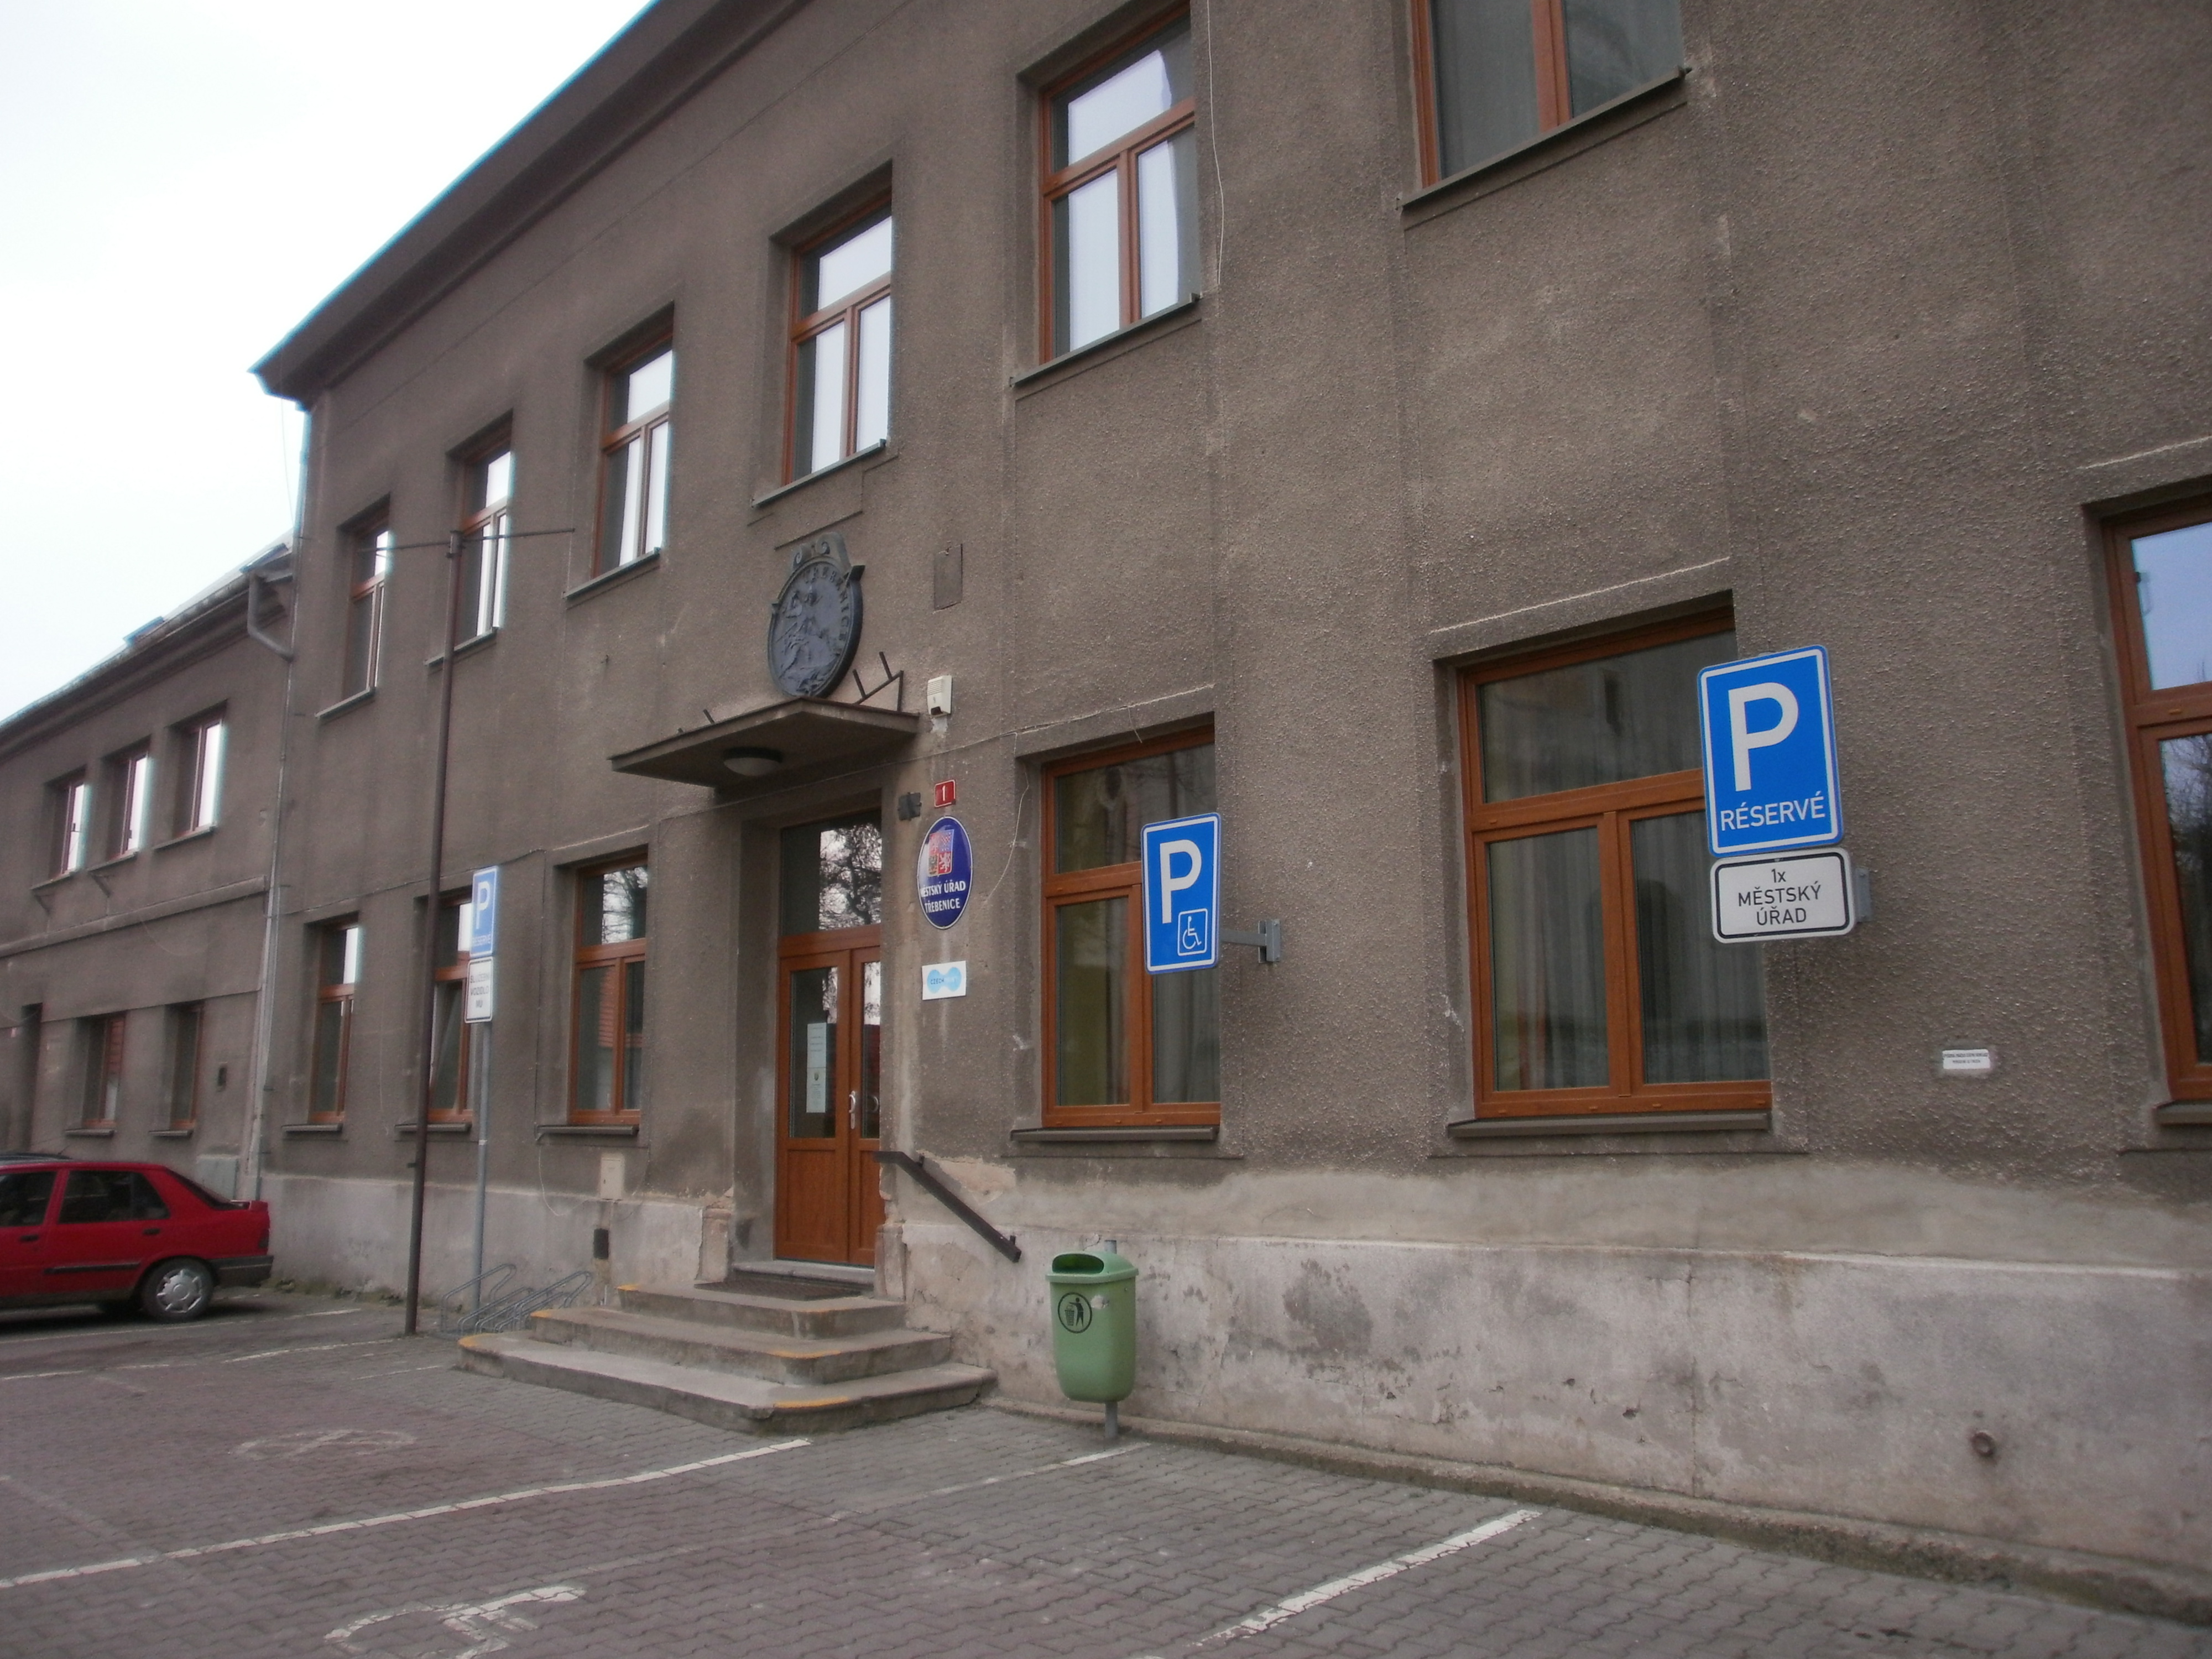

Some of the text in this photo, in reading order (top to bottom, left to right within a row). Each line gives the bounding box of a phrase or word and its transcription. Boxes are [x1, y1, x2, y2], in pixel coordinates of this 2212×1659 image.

[1728, 682, 1799, 792] P
[942, 785, 946, 801] 1
[1720, 791, 1825, 831] RÉSERVÉ
[943, 879, 966, 893] ÚŘAD
[1160, 839, 1202, 924] P
[1771, 868, 1786, 883] 1x
[476, 881, 491, 929] P
[1739, 880, 1821, 907] MĚSTSKÝ
[925, 898, 961, 914] TŘEBENICE
[1756, 906, 1807, 926] ÚŘAD
